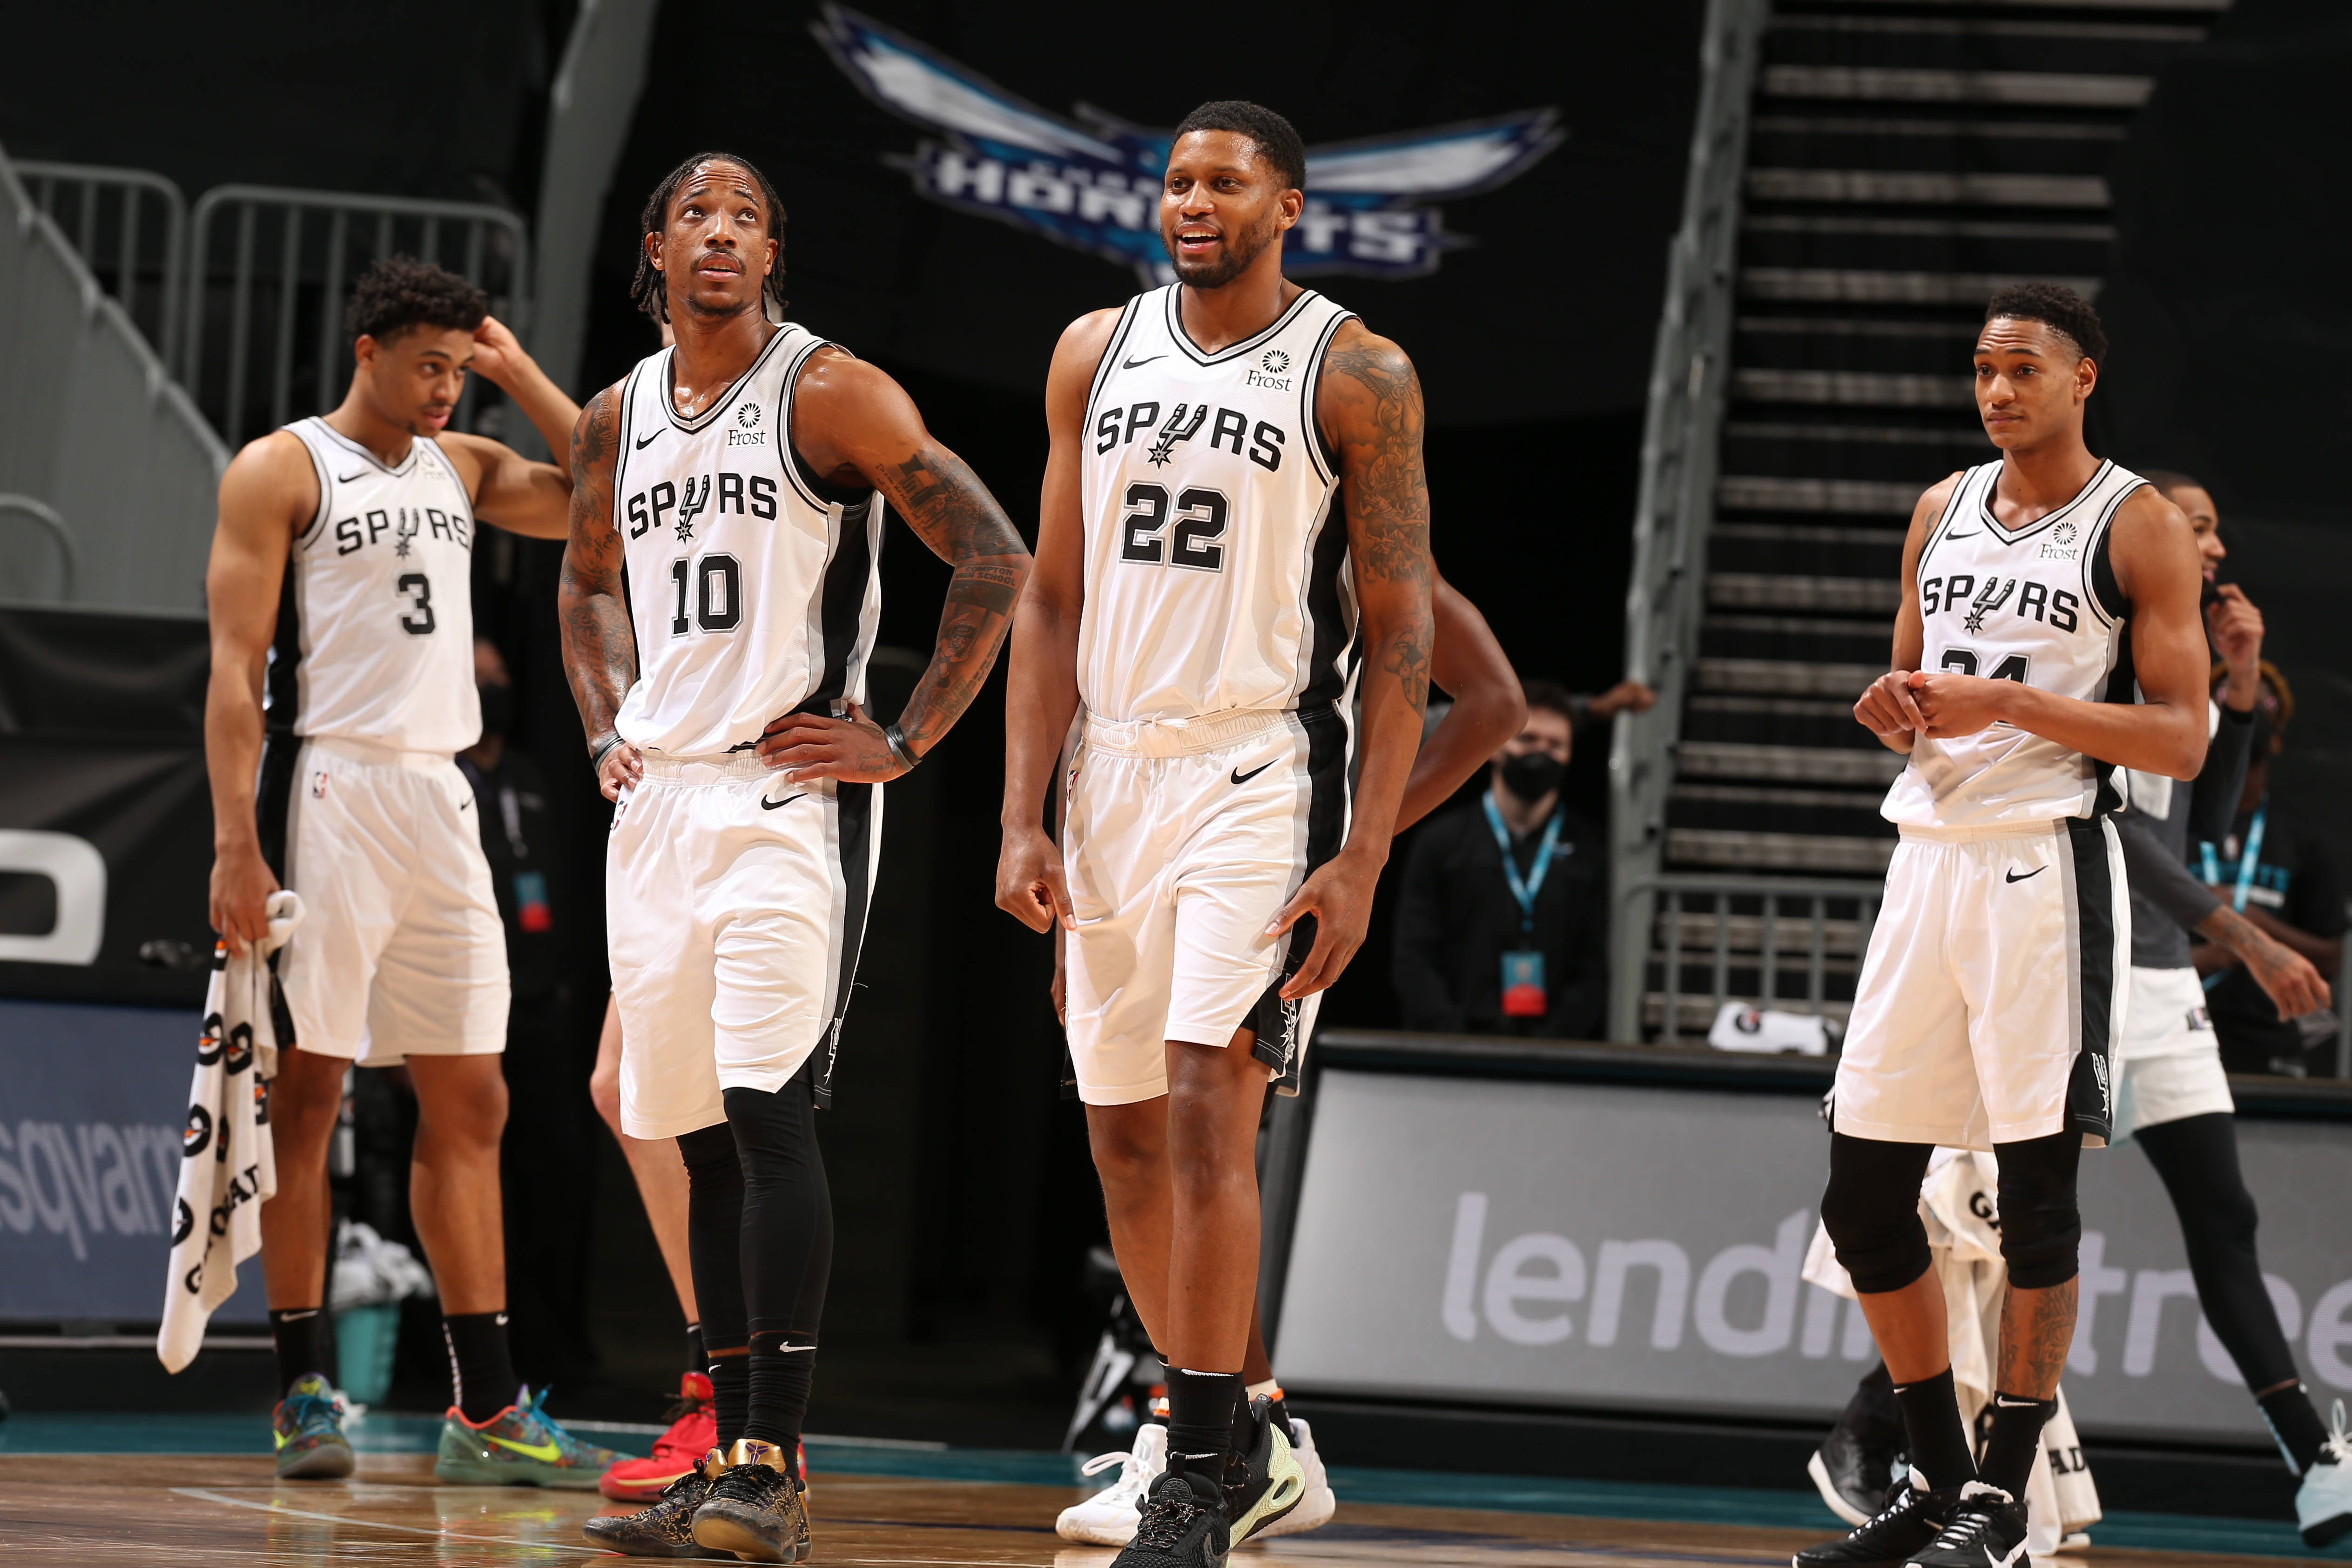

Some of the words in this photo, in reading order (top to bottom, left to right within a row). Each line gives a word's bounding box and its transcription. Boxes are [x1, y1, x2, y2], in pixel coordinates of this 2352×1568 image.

[935, 150, 1418, 263] HORTS
[1246, 370, 1292, 391] Frost
[728, 430, 766, 446] Frost
[1097, 401, 1286, 473] SPURS
[336, 508, 471, 559] SPURS
[628, 473, 777, 545] SPURS
[1119, 480, 1232, 573] 22
[965, 566, 1014, 576] COMPTON
[977, 572, 1015, 586] SCHOOL
[2039, 544, 2079, 561] Frost
[396, 571, 436, 637] 3
[670, 552, 744, 639] 10
[1923, 575, 2079, 637] SPURS
